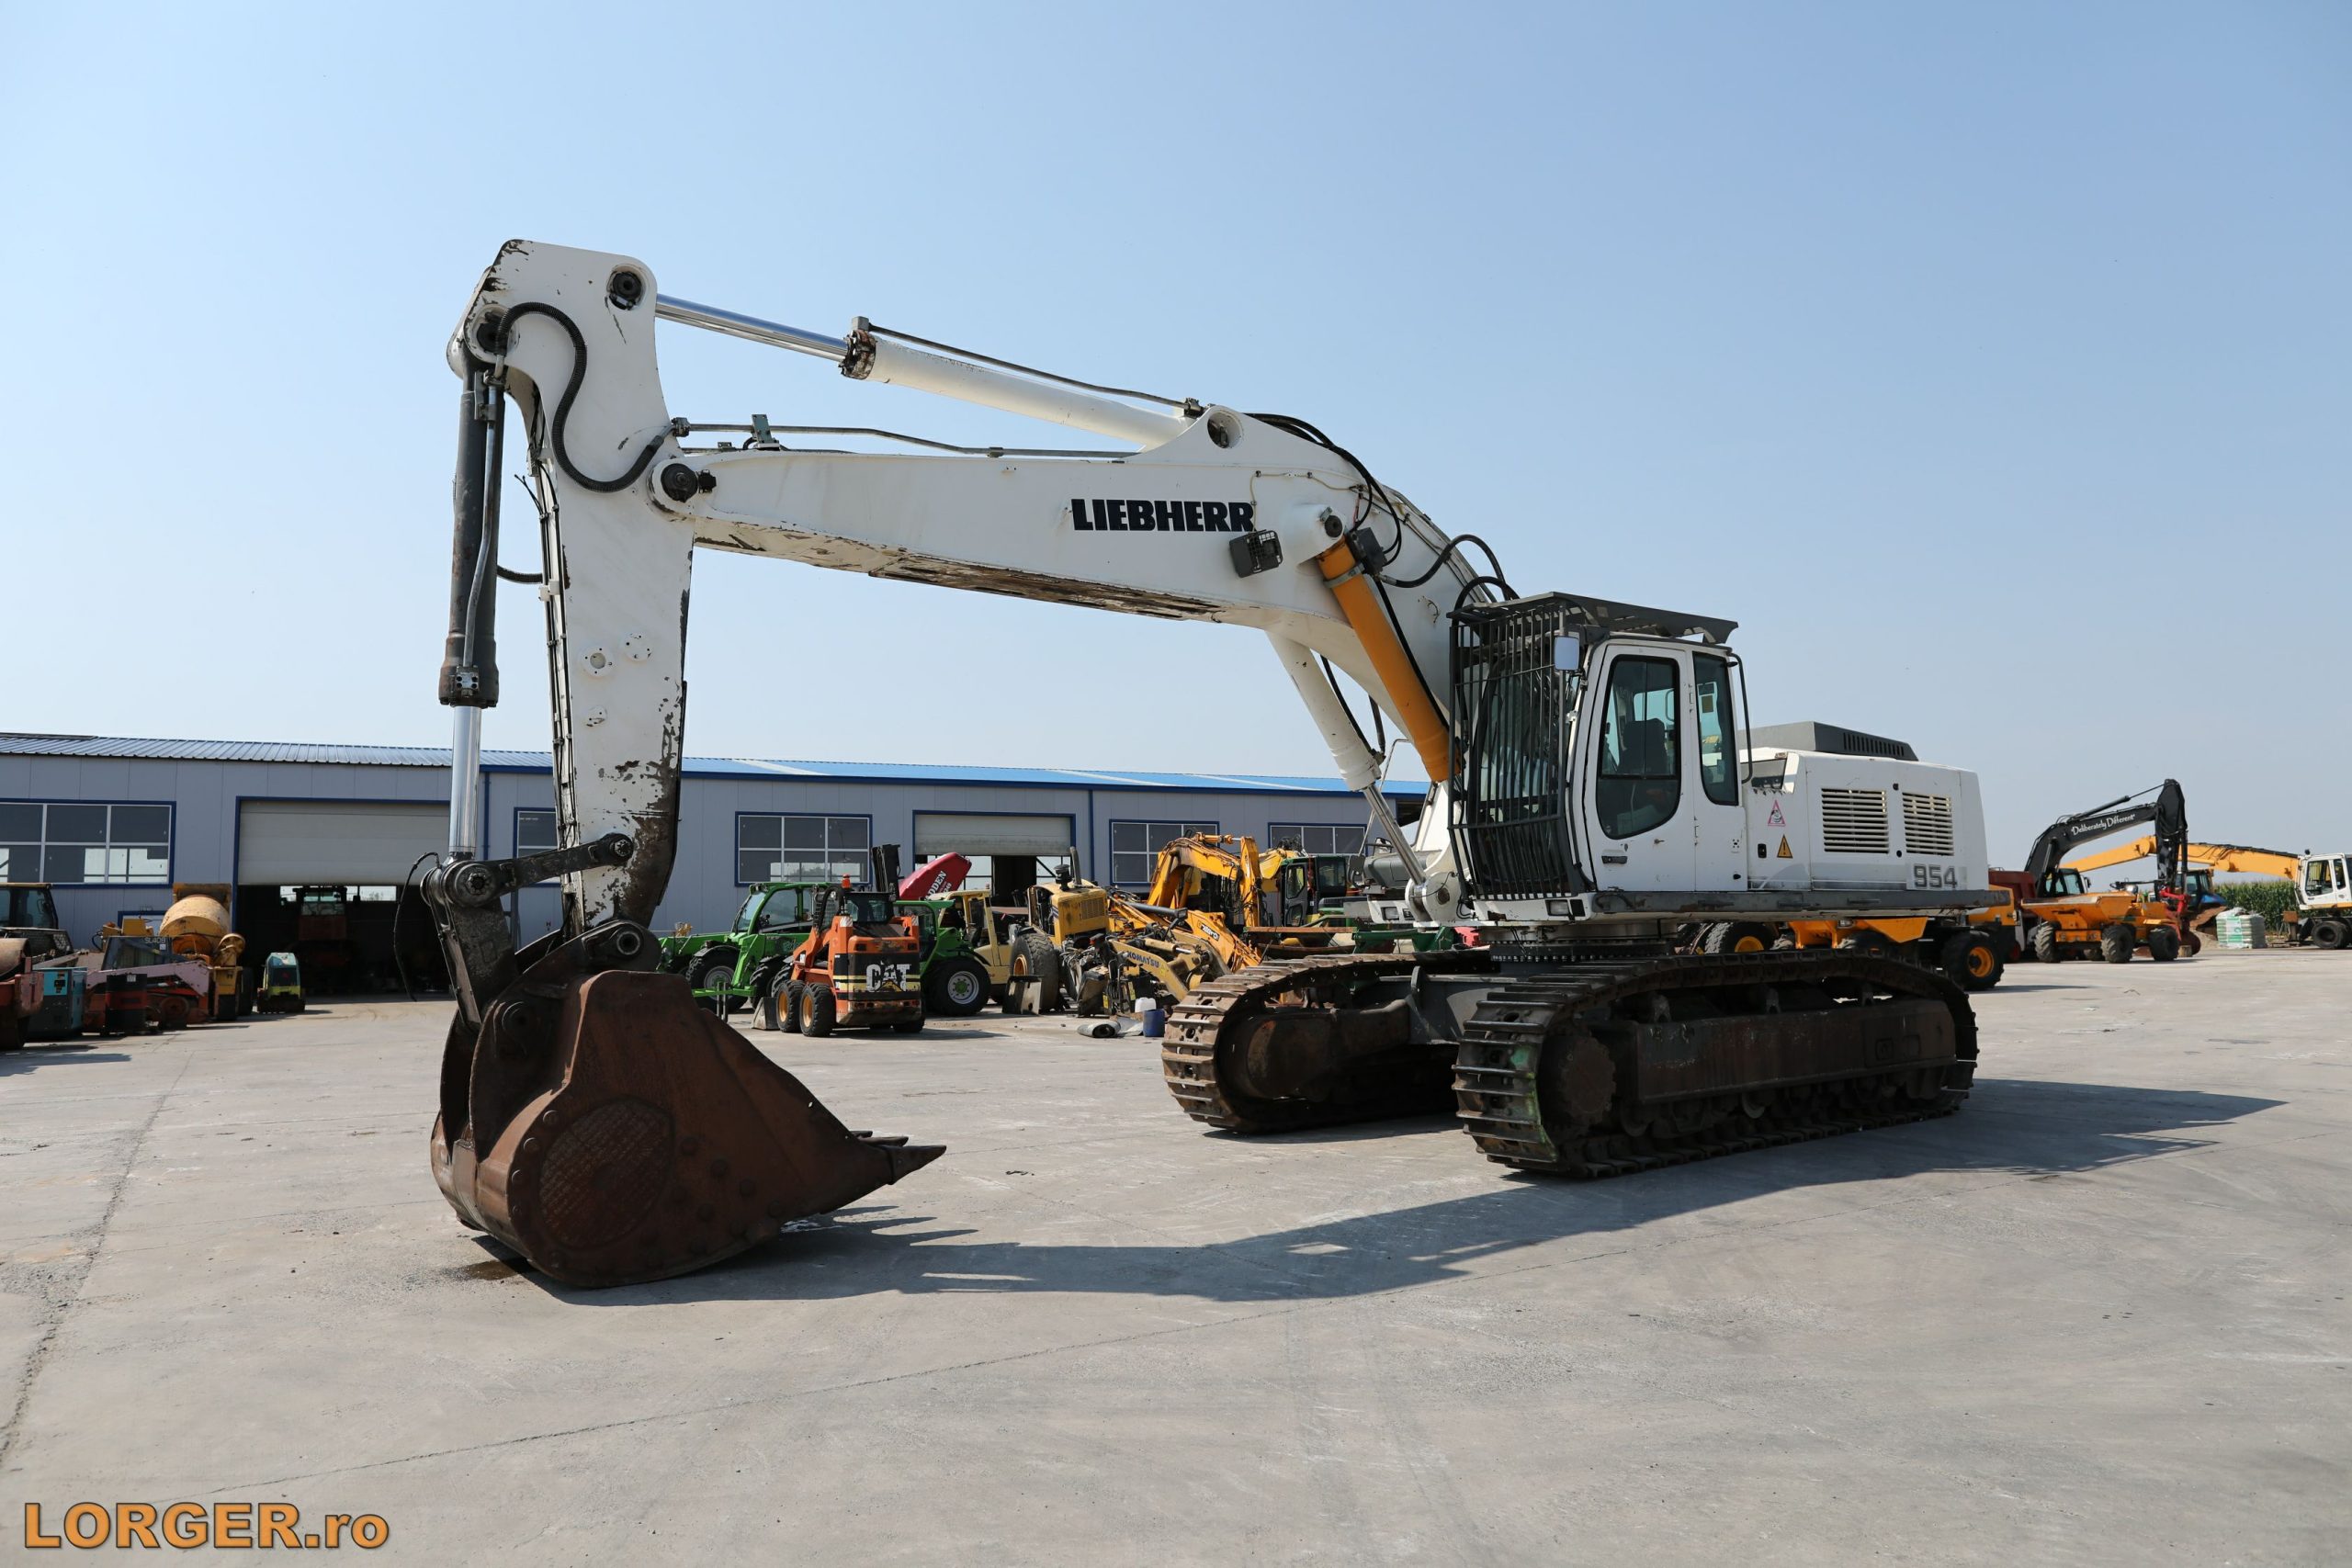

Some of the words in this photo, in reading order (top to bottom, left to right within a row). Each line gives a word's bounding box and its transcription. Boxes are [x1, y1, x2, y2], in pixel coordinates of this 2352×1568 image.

[1071, 499, 1254, 532] LIEBHERR
[1913, 865, 1957, 888] 954
[1127, 950, 1159, 968] KOMATSU
[865, 963, 911, 992] CAT
